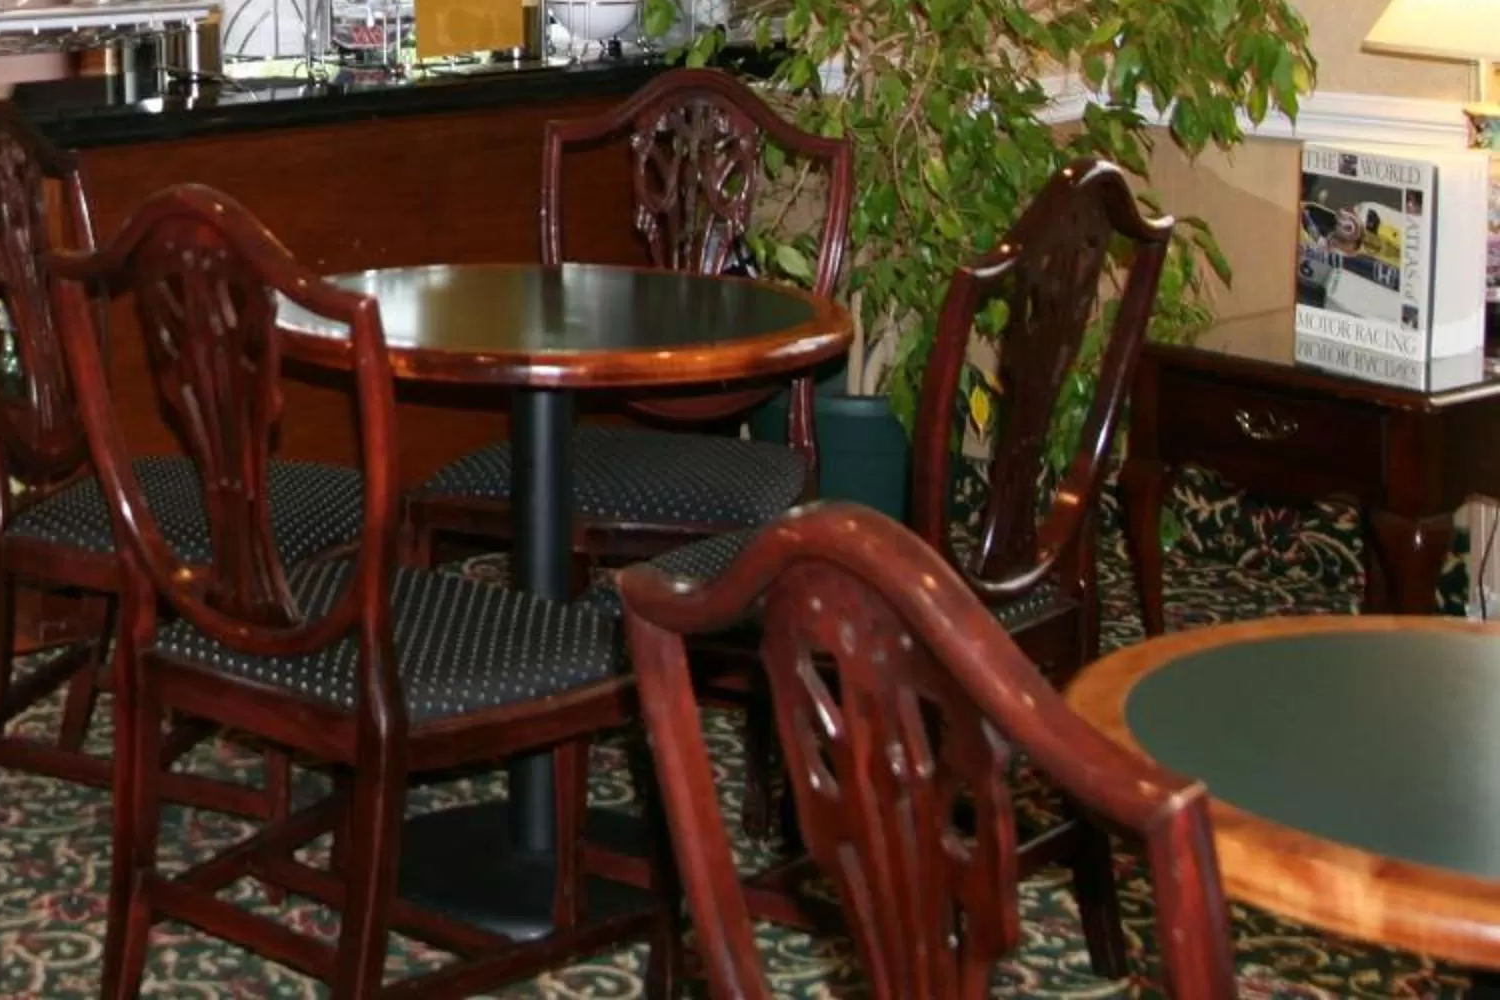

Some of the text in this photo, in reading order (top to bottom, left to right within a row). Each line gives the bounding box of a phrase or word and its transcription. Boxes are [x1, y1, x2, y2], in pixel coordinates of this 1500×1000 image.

[1306, 150, 1422, 184] THE WORLD
[1405, 217, 1421, 280] ATLAS
[1298, 310, 1417, 355] MOTOR RACING
